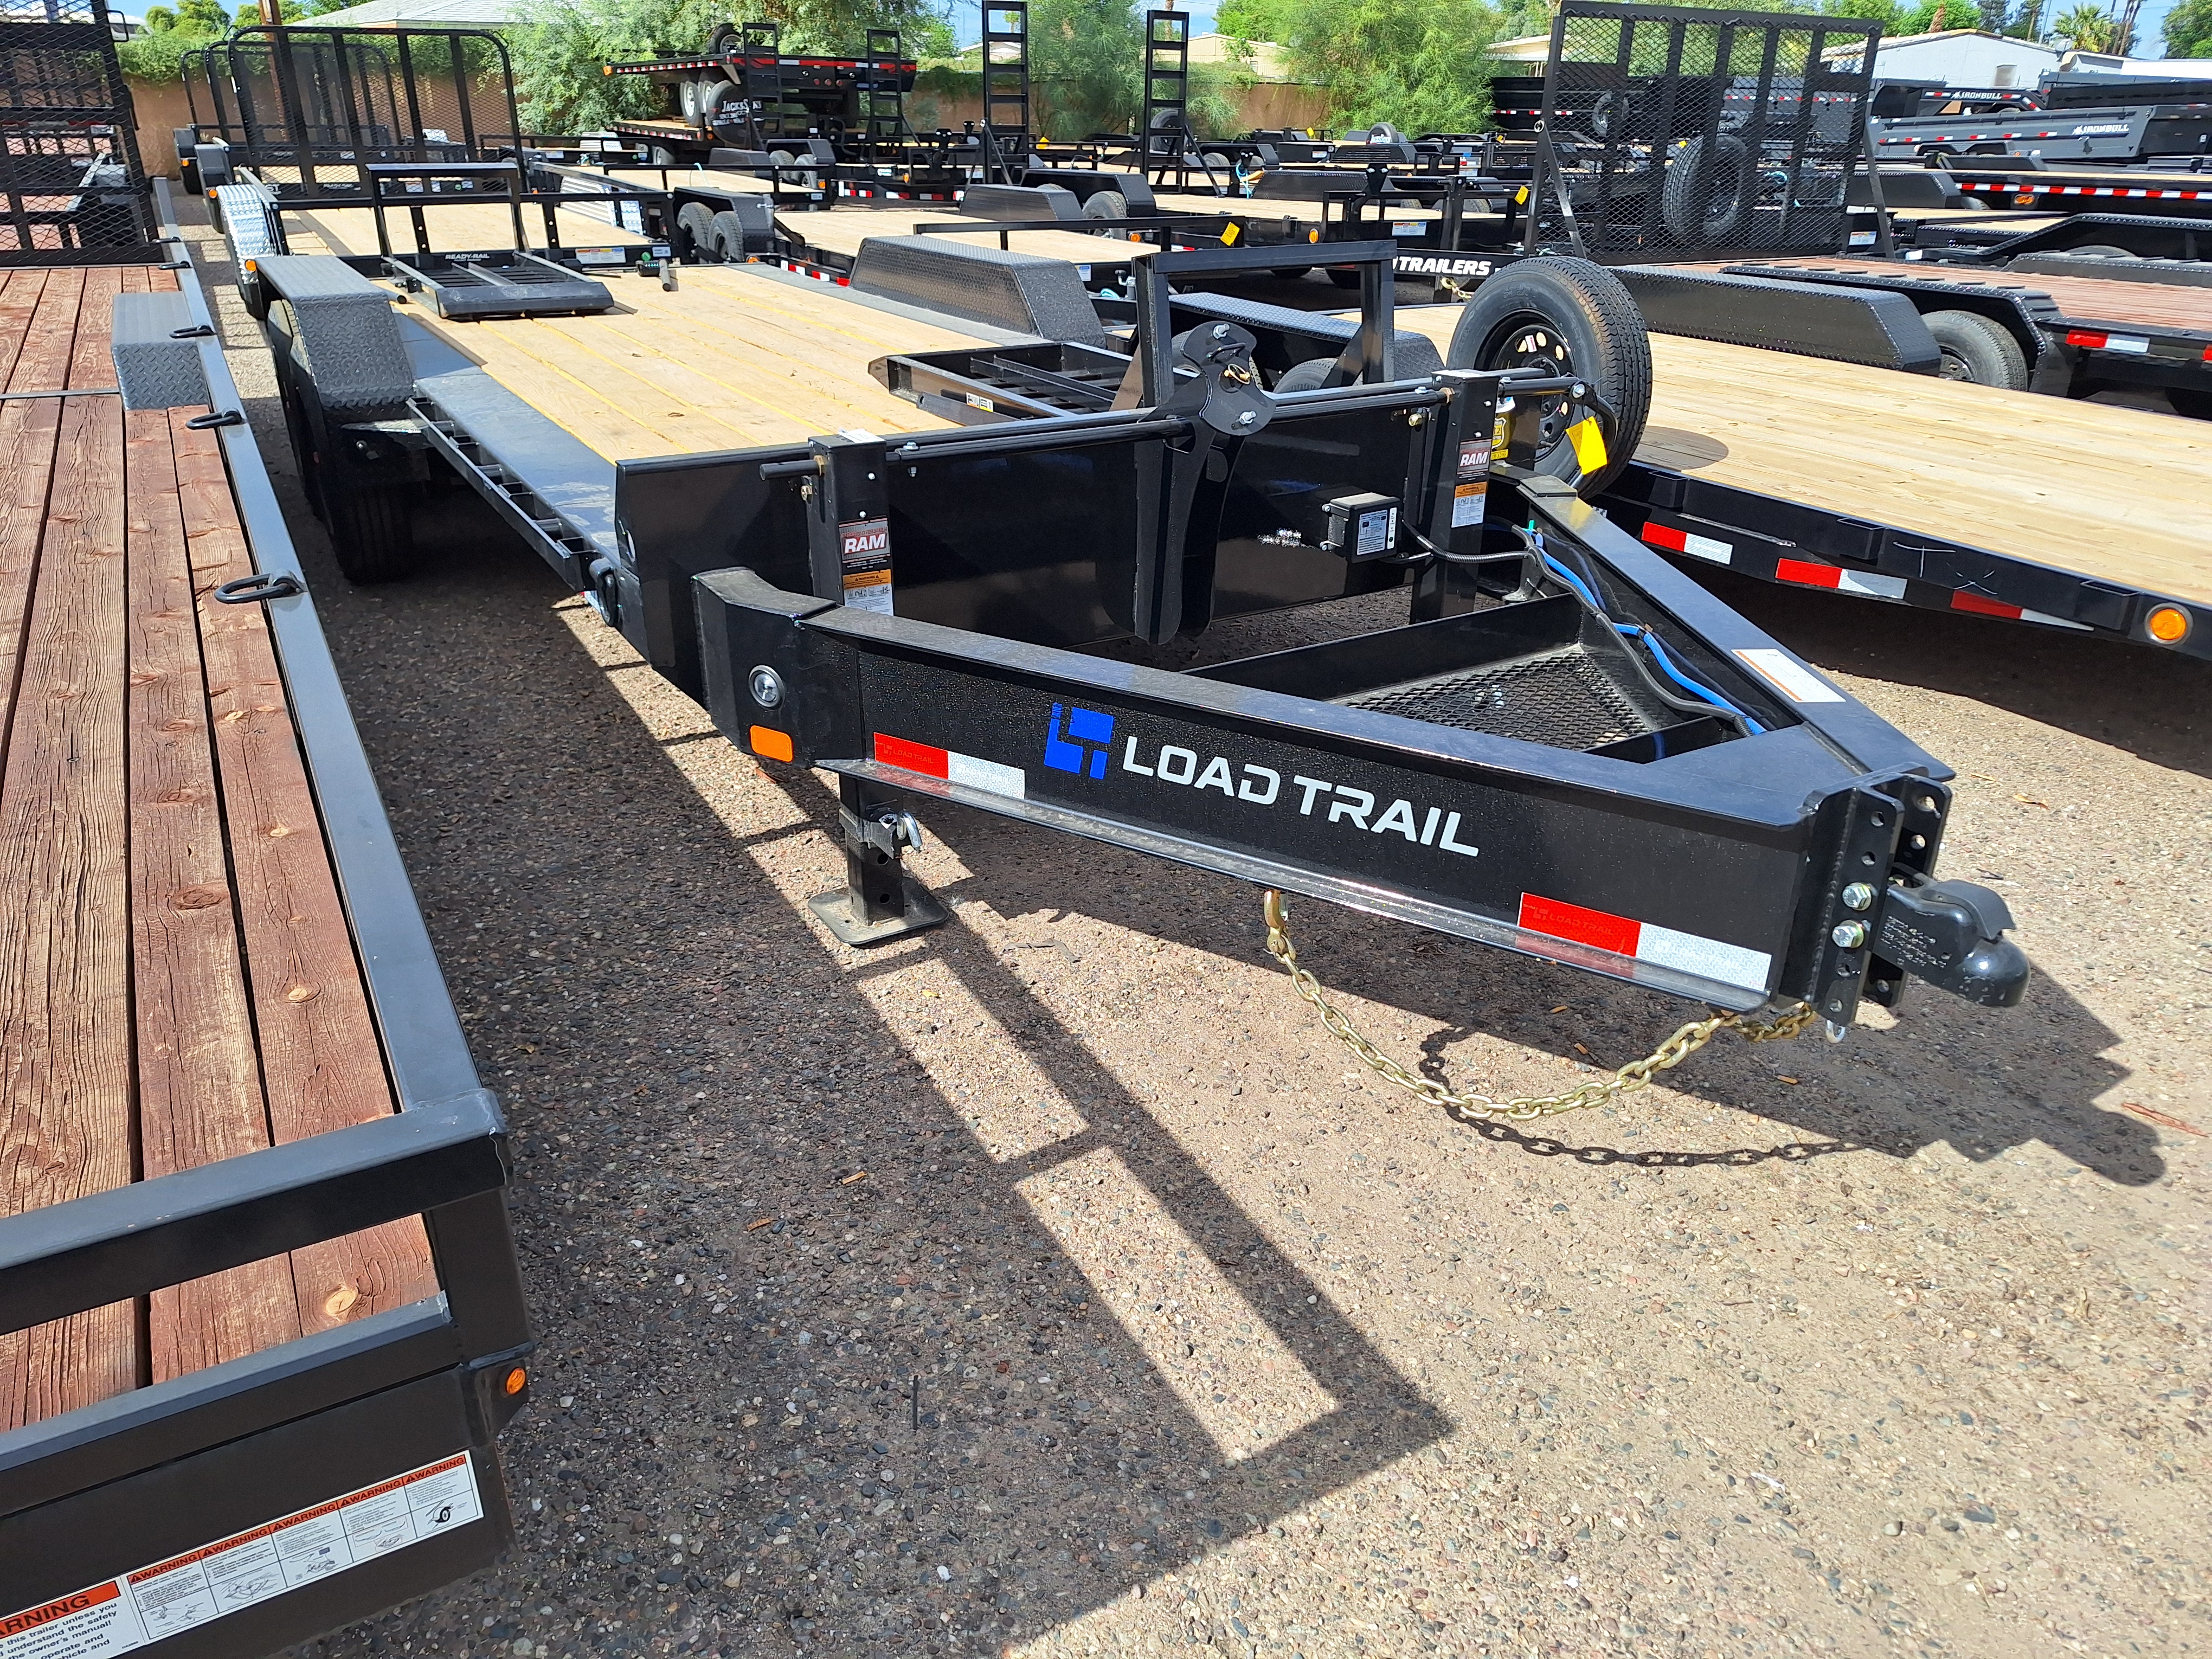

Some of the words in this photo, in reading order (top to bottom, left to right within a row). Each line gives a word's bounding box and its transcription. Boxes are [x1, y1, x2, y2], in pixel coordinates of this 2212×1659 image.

[1961, 91, 2002, 100] IRONBULL
[2083, 124, 2130, 134] IRONBULL
[1399, 256, 1492, 276] TRAILERS
[1459, 452, 1489, 467] RAM
[844, 533, 886, 554] RAM
[1123, 736, 1281, 806] LOAD
[1293, 775, 1479, 857] TRAIL
[415, 1458, 464, 1479] WARNING
[350, 1481, 401, 1503] WARNING
[282, 1504, 336, 1526] WARNING
[213, 1528, 267, 1551] WARNING
[140, 1554, 197, 1578] WARNING
[0, 1594, 91, 1635] RNING
[7, 1636, 26, 1645] this
[29, 1623, 59, 1637] trailer
[62, 1611, 96, 1625] unless
[98, 1603, 117, 1613] you
[8, 1629, 65, 1654] understand
[68, 1623, 84, 1632] the
[87, 1611, 117, 1625] safety
[29, 1637, 69, 1654] owner's
[41, 1643, 81, 1659] operate
[85, 1633, 104, 1644] and
[91, 1639, 110, 1650] and
